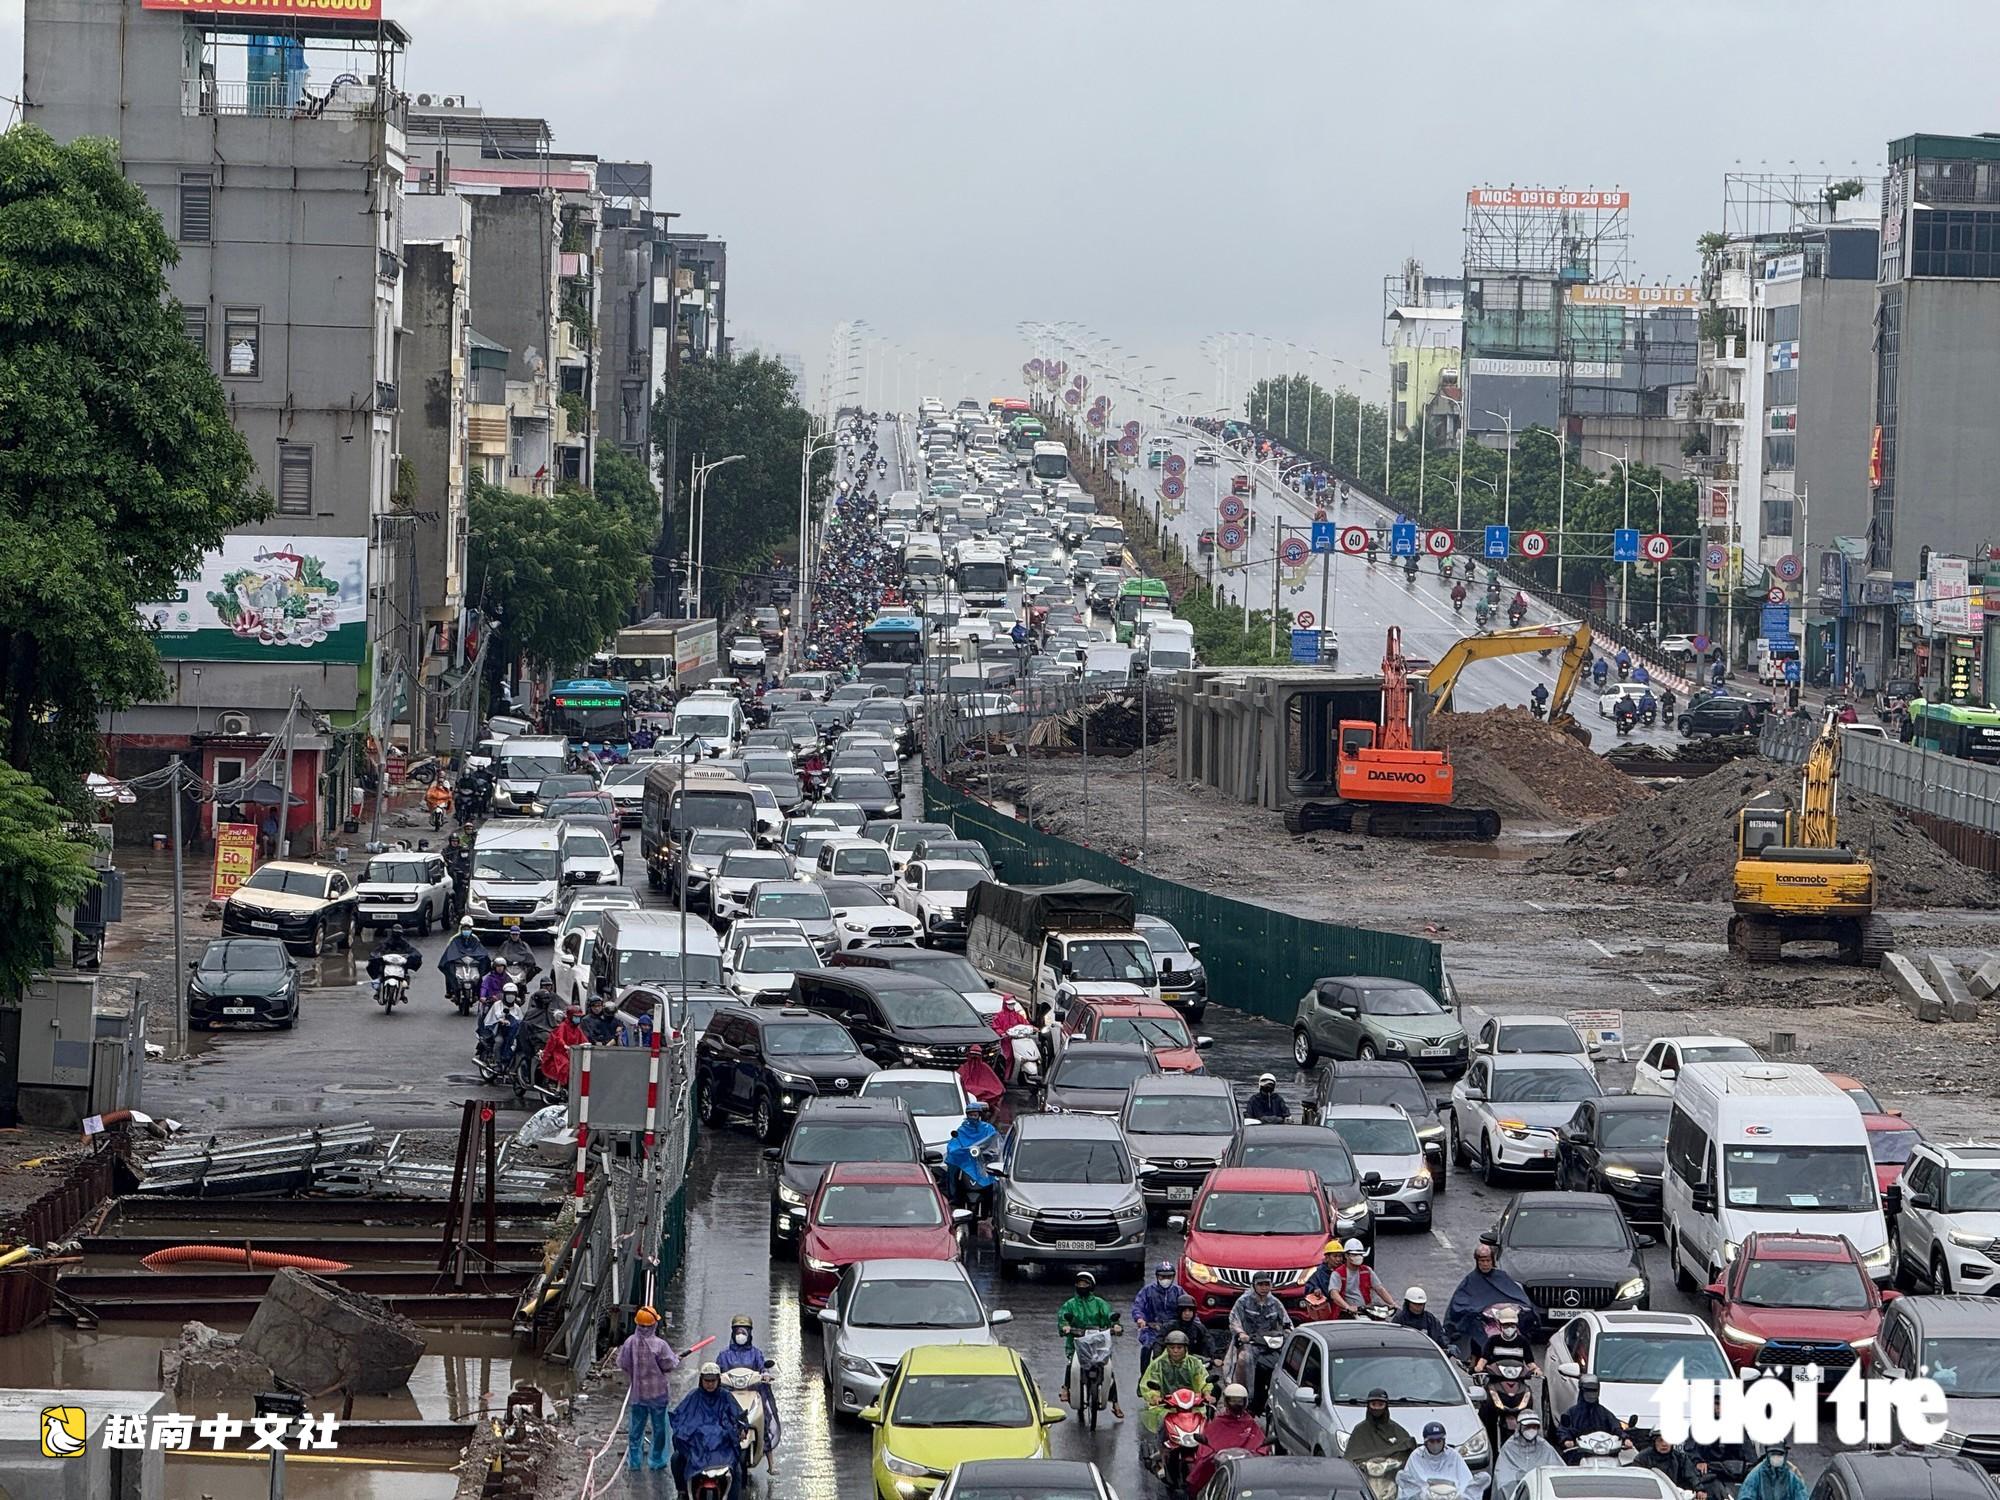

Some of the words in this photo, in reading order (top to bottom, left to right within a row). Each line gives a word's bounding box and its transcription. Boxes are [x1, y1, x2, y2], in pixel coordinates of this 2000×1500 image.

[1479, 190, 1517, 204] MQC:
[1520, 192, 1556, 204] 0916
[1559, 192, 1578, 205] 80
[1581, 193, 1599, 205] 20
[1603, 193, 1621, 205] 99
[1583, 286, 1633, 300] MQC:
[1638, 288, 1685, 302] 0916
[1348, 534, 1361, 547] 60
[1434, 536, 1447, 549] 60
[1527, 538, 1540, 551] 60
[1652, 541, 1665, 554] 40
[1367, 770, 1426, 784] DAEWOO
[223, 852, 249, 865] 50%
[1776, 873, 1828, 884] kanamoto
